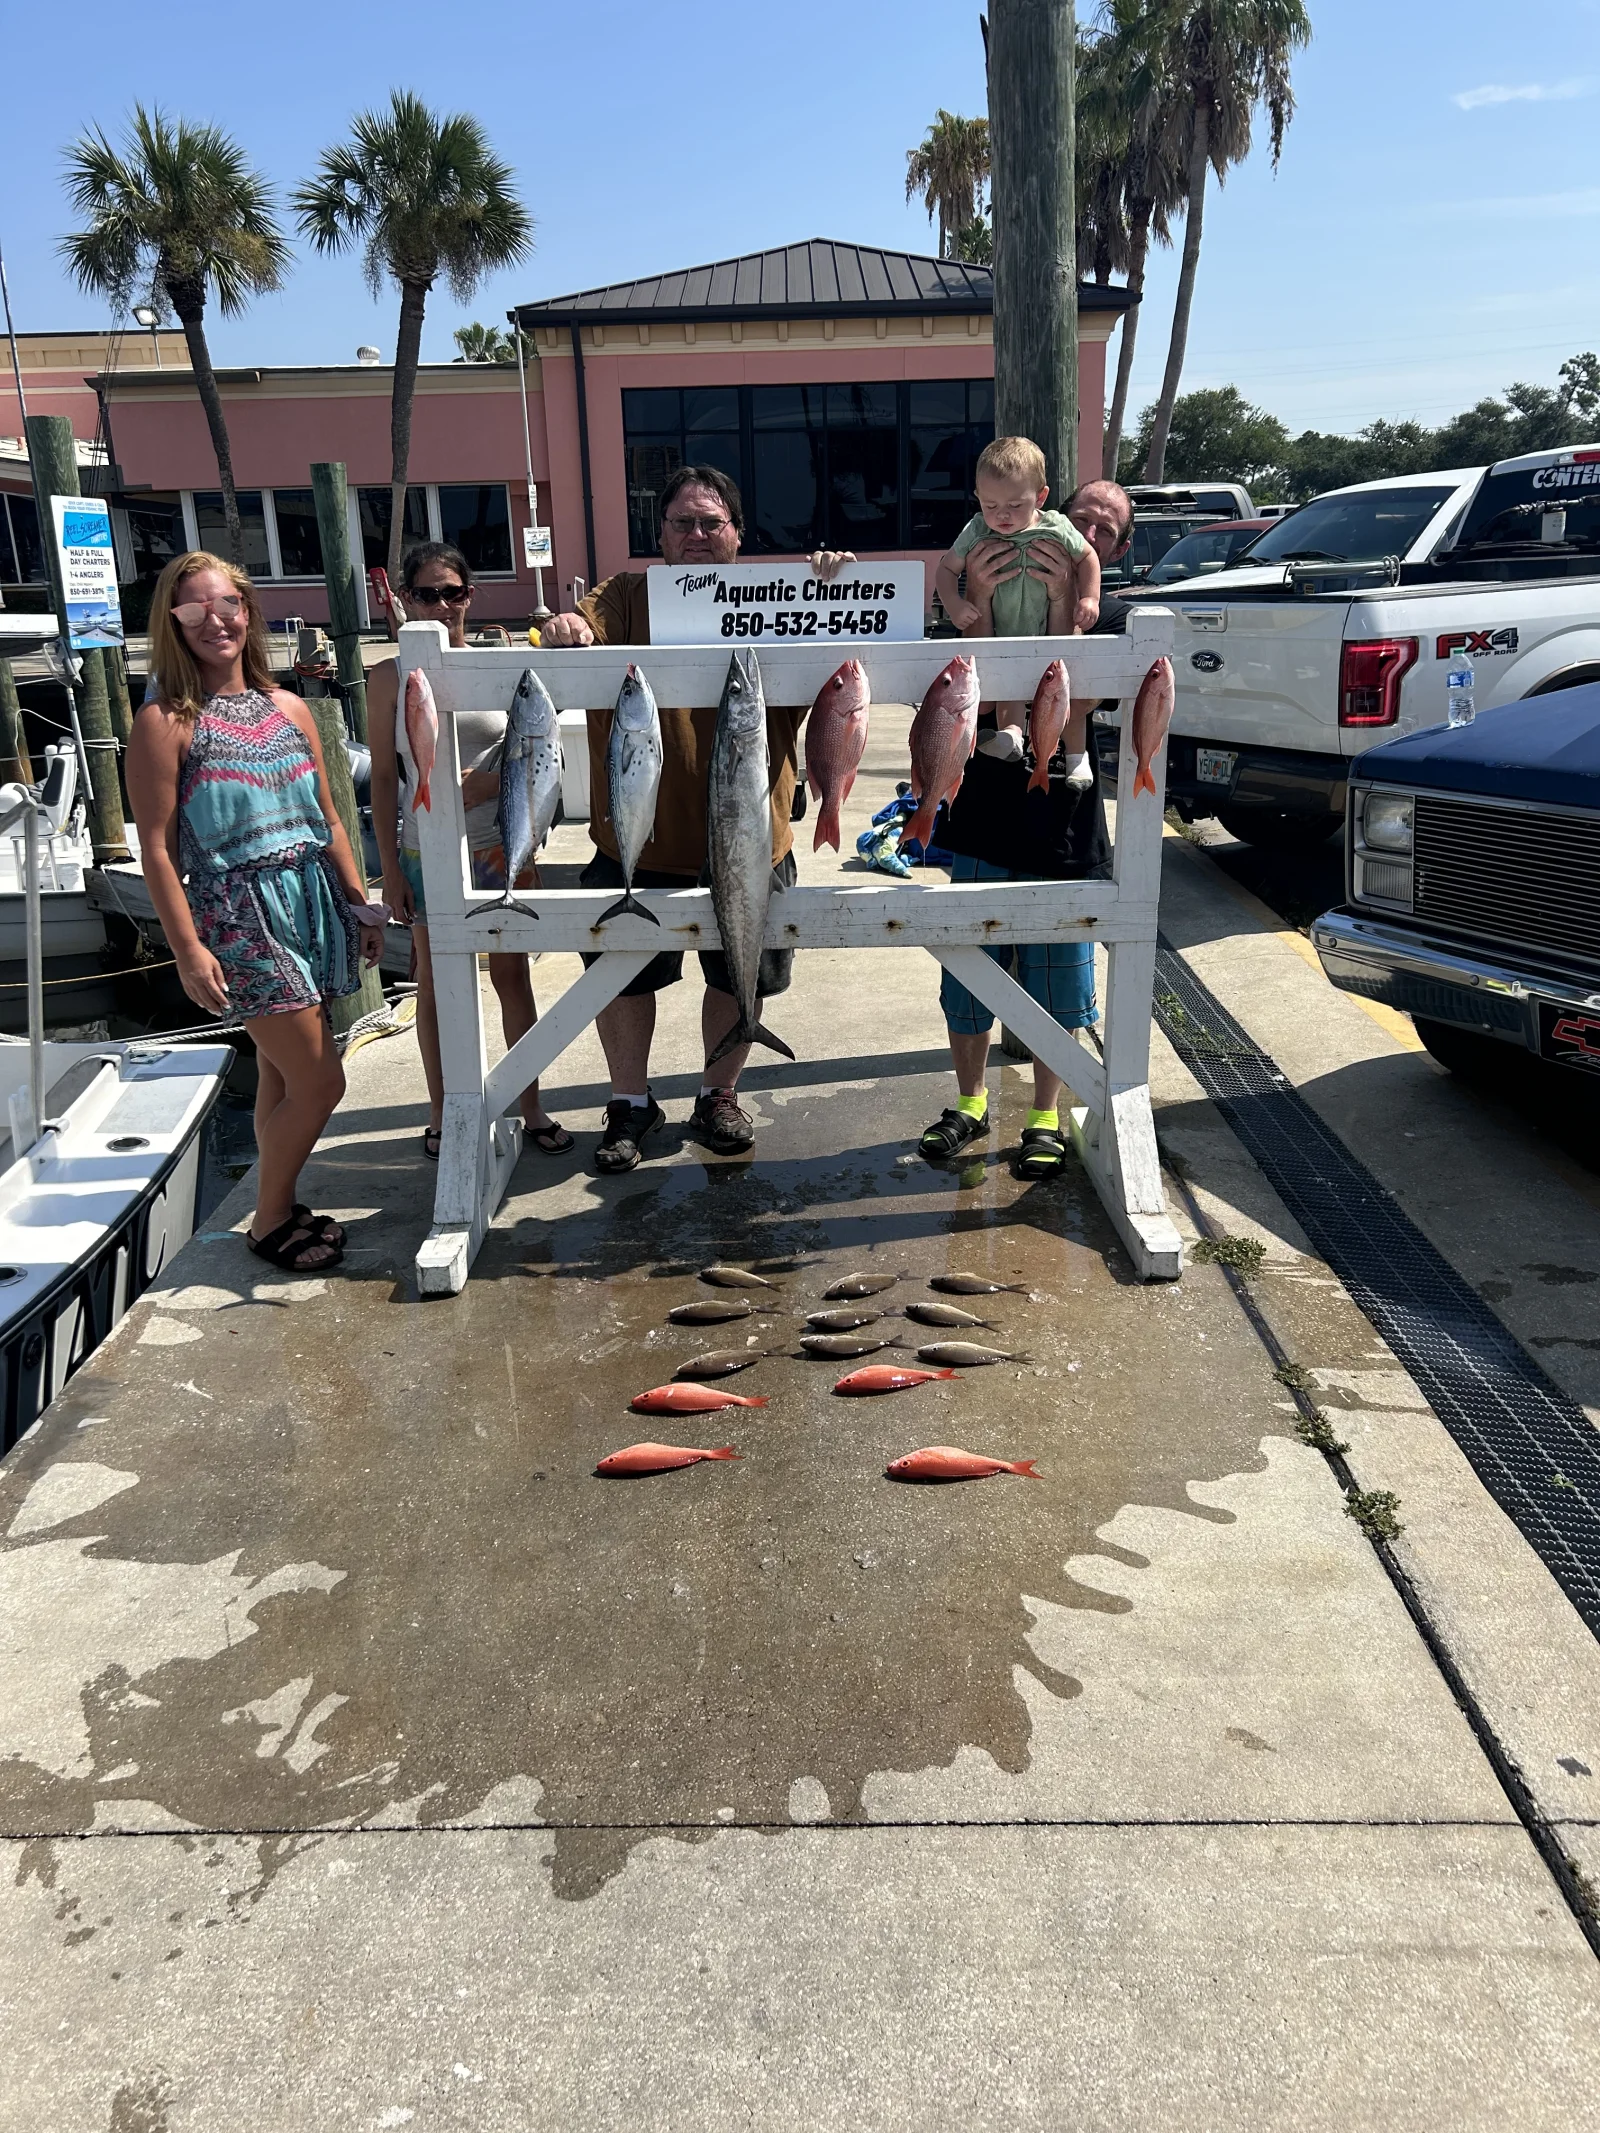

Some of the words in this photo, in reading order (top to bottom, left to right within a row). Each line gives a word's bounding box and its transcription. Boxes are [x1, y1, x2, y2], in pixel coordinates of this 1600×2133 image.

[69, 549, 84, 557] HALF
[90, 549, 105, 557] FULL
[82, 558, 111, 566] CHARTERS
[69, 571, 79, 579] 1-4
[79, 571, 104, 579] ANGLERS
[675, 571, 720, 598] Team
[713, 578, 797, 608] Aquatic
[802, 578, 896, 602] Charters
[721, 609, 889, 637] 850-532-5458
[1436, 627, 1519, 660] FX4
[1494, 648, 1518, 656] ROAD
